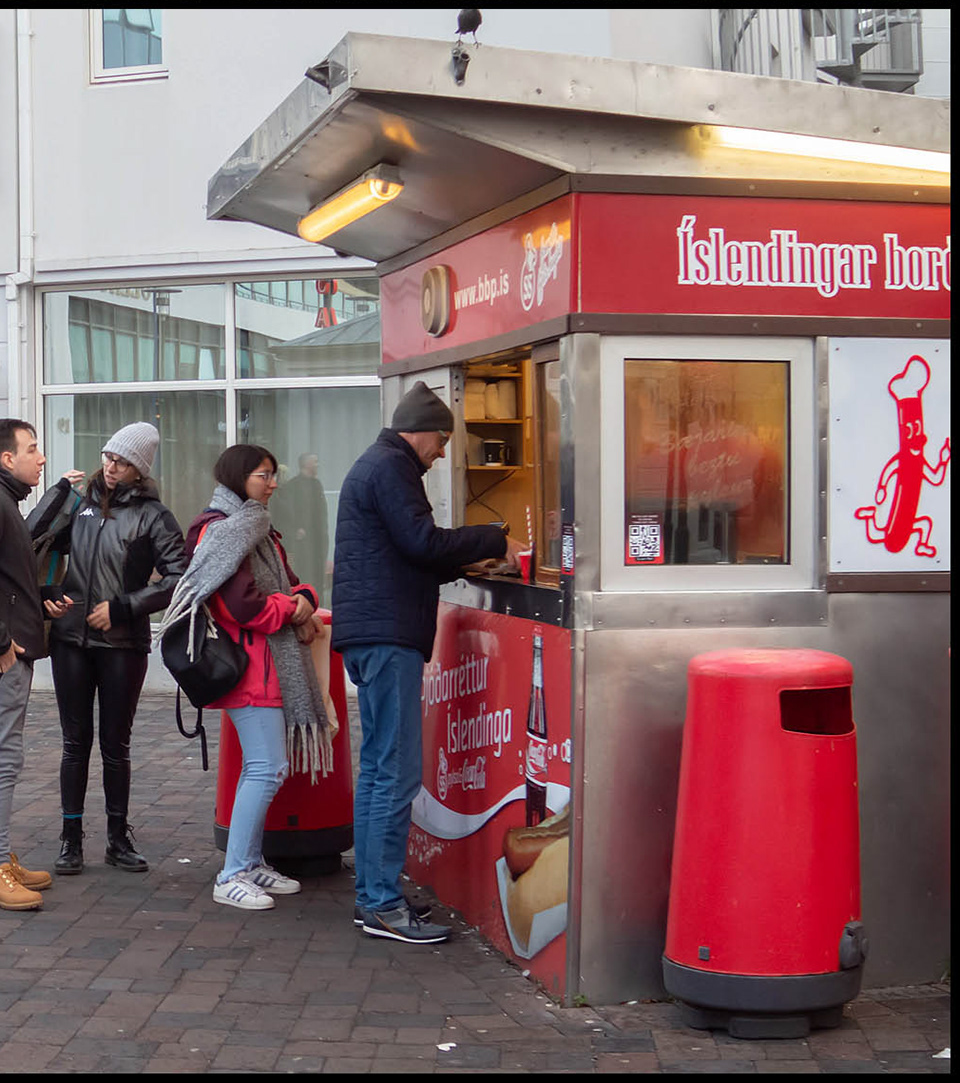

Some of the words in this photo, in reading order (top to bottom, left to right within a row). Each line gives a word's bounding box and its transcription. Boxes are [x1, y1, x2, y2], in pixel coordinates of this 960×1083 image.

[677, 215, 877, 298] Íslendingar
[453, 269, 509, 311] www.bbp.is
[447, 702, 512, 757] Íslendinga
